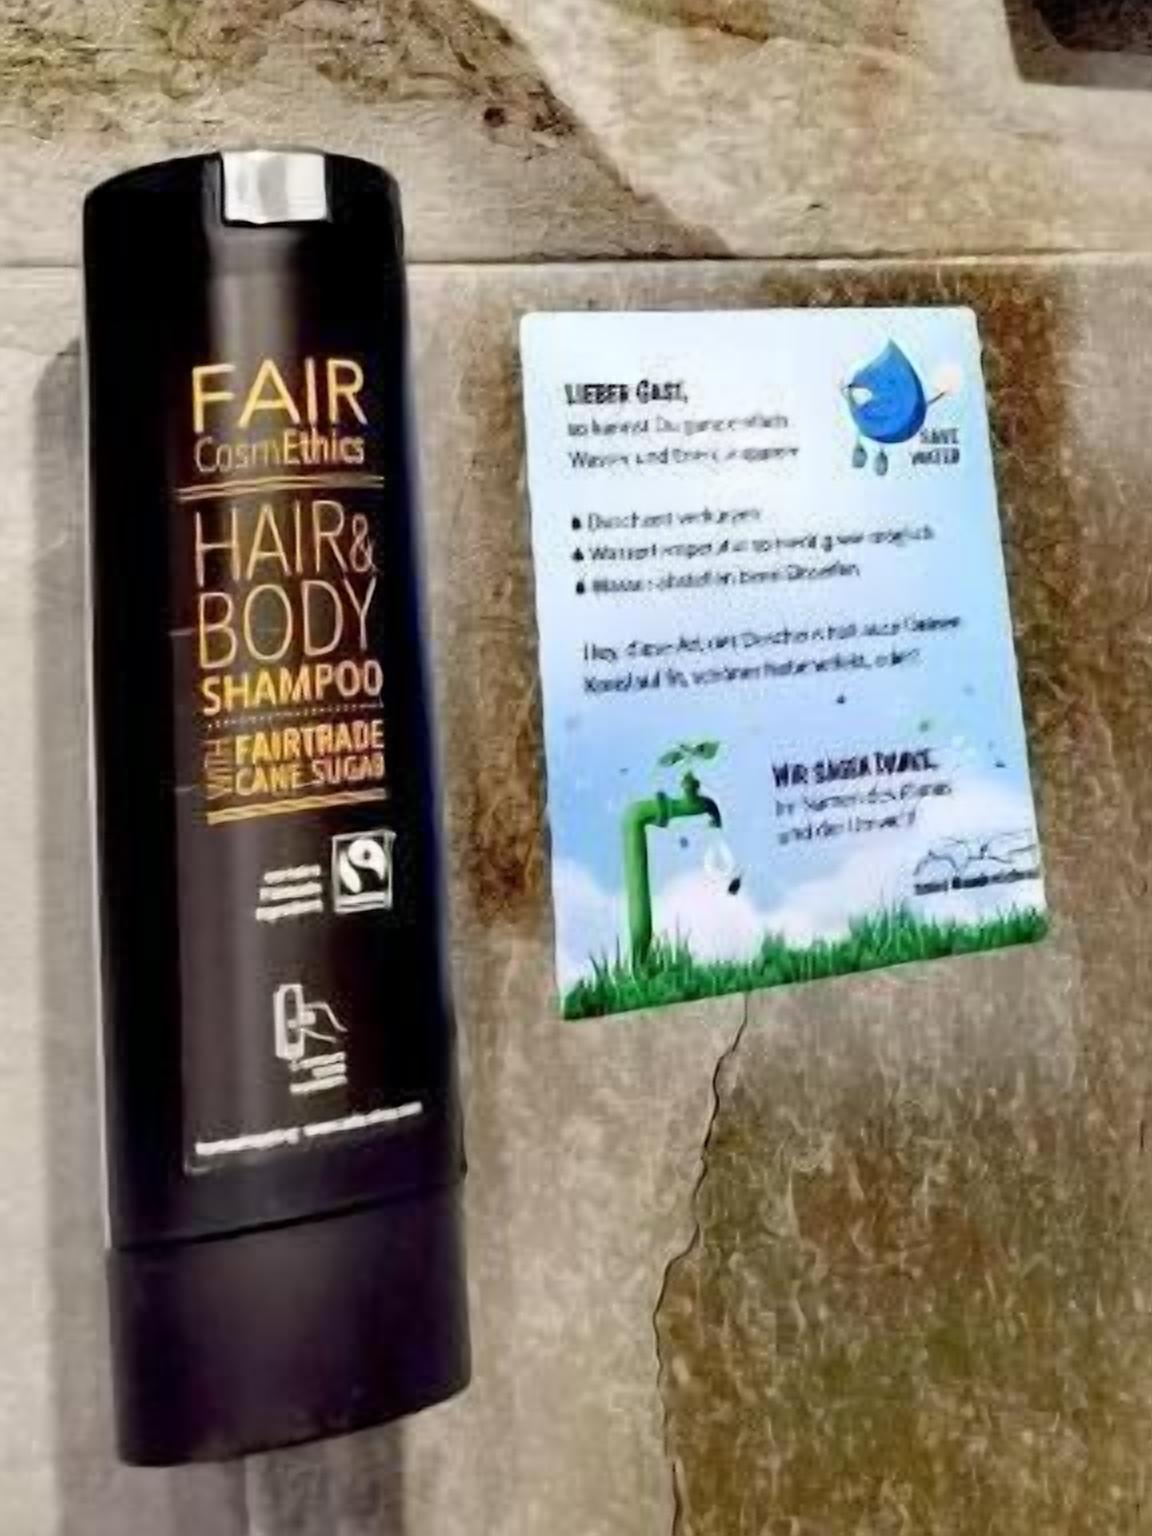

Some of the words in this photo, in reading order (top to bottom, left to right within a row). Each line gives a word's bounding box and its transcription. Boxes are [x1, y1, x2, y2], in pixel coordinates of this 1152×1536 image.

[192, 357, 368, 433] FAIR
[194, 428, 366, 473] CosmEthics
[199, 575, 377, 669] BODY
[202, 659, 385, 716] SHAMPOO
[235, 719, 385, 766] FAIRTRADE
